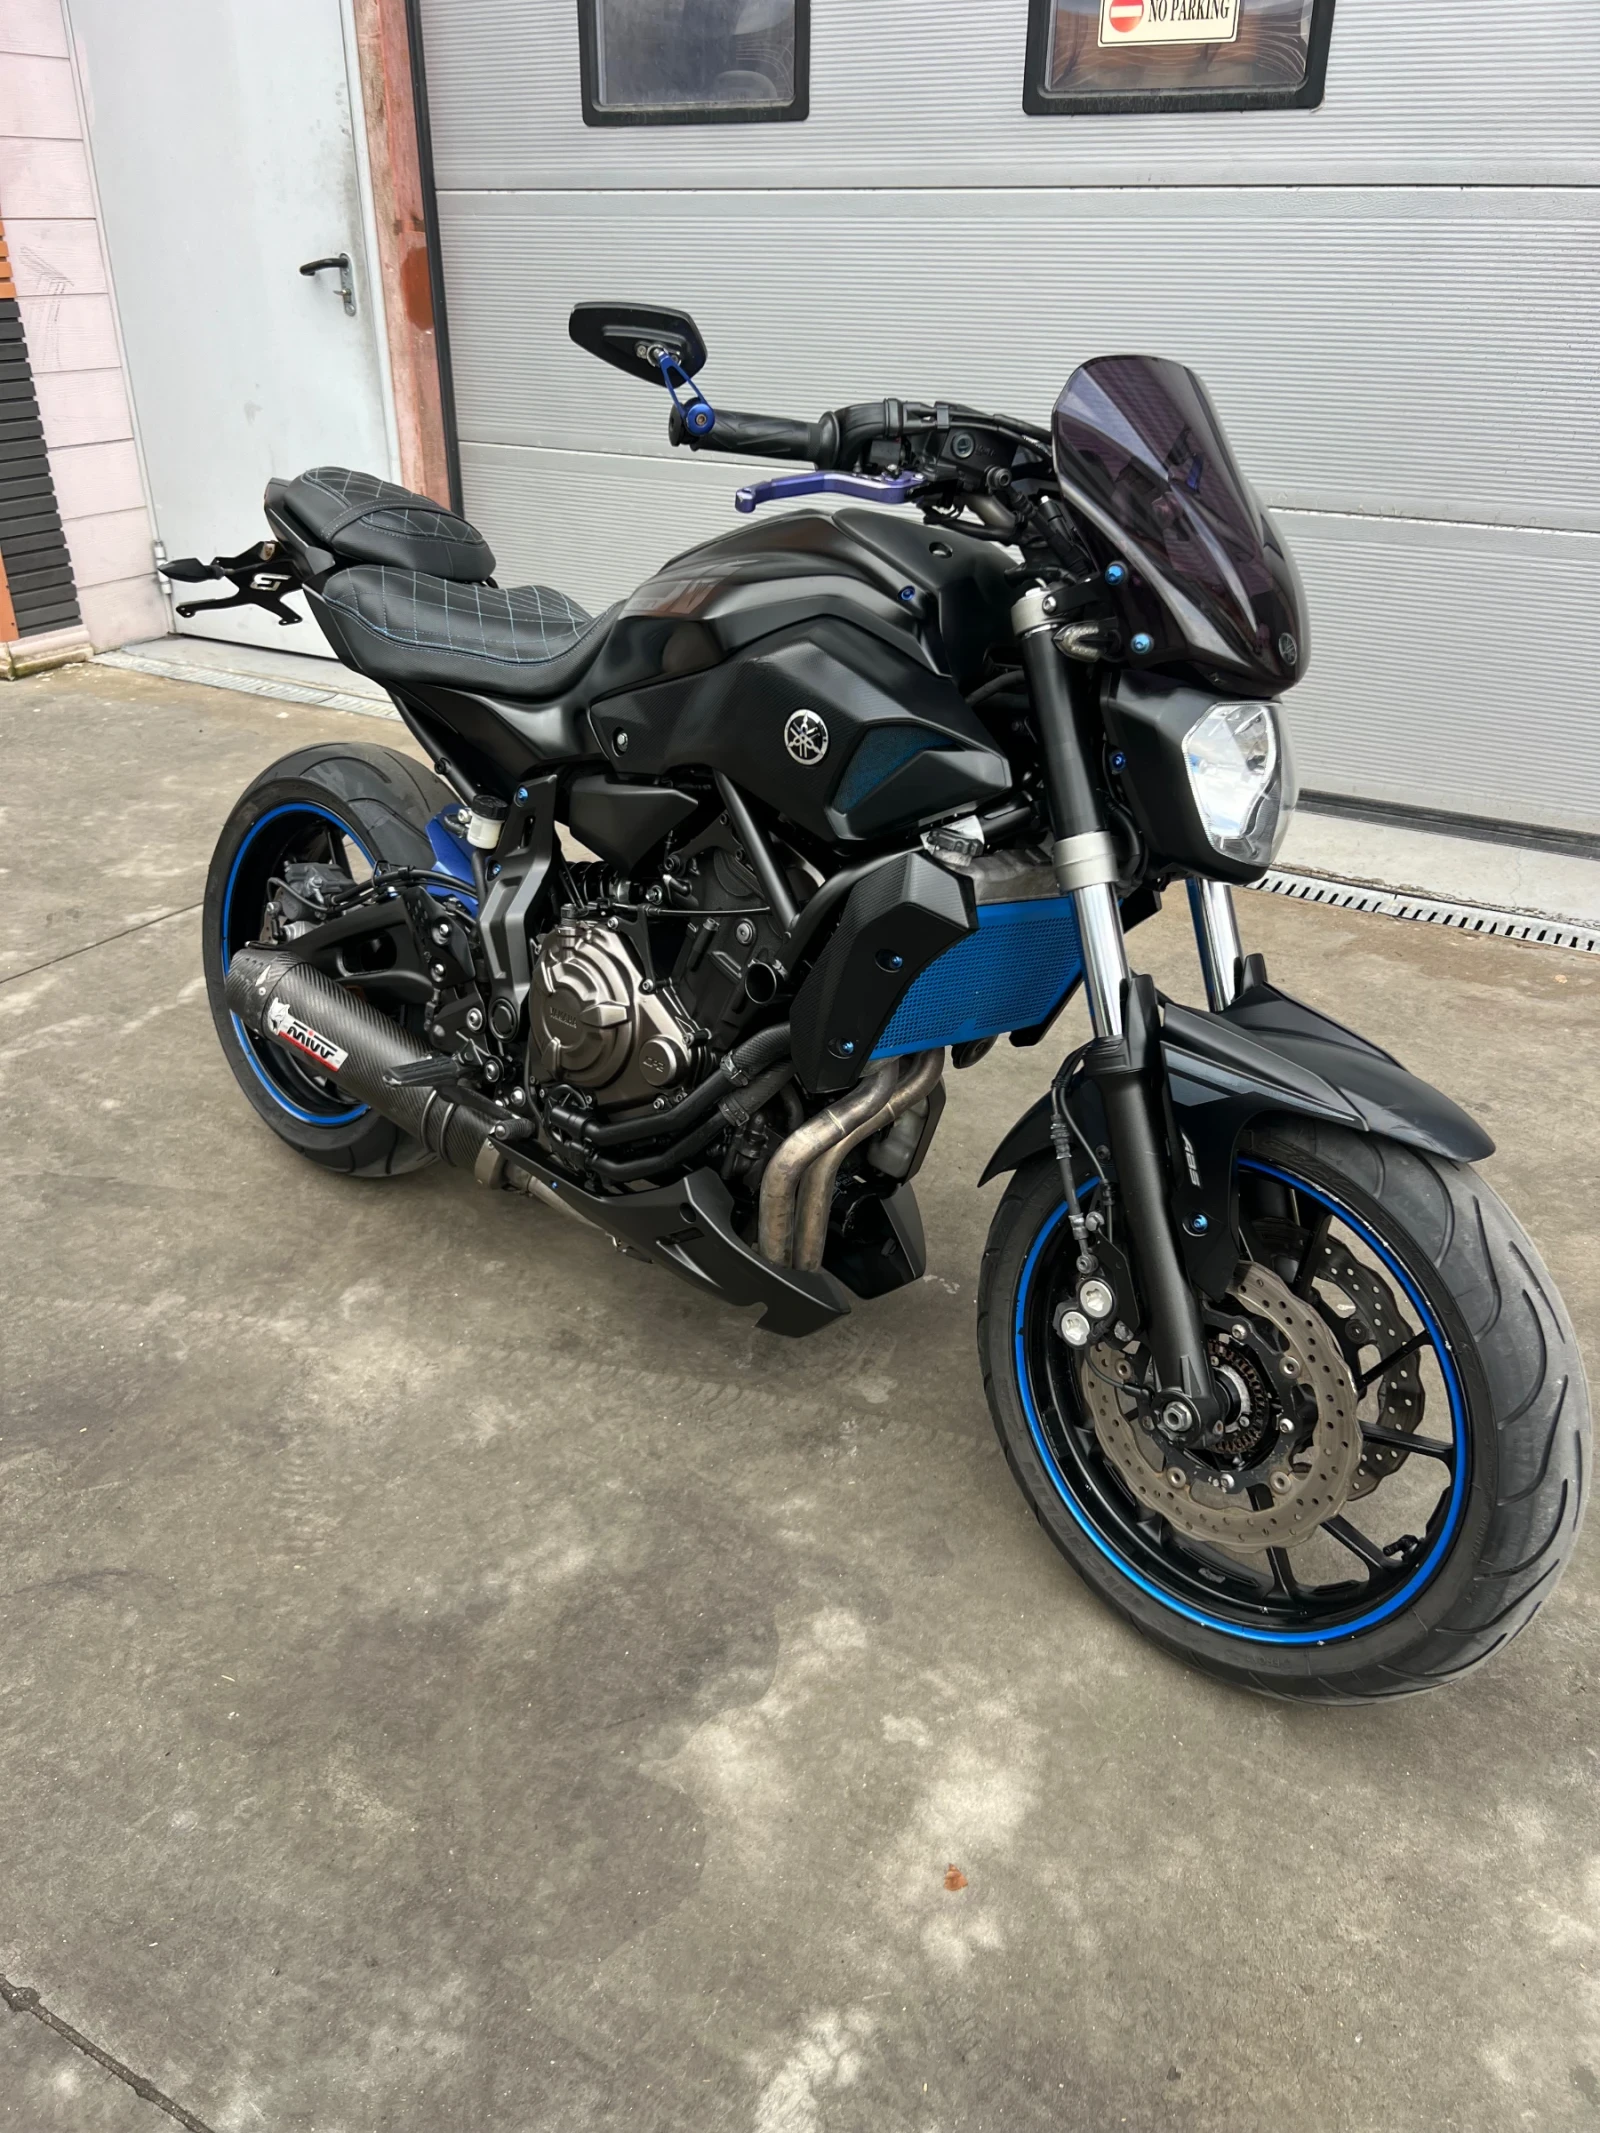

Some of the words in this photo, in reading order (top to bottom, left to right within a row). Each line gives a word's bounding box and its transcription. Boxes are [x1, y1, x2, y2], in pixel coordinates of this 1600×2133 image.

[1148, 0, 1167, 22] NO
[1170, 0, 1229, 21] PARKING
[1182, 1132, 1200, 1187] ABS
